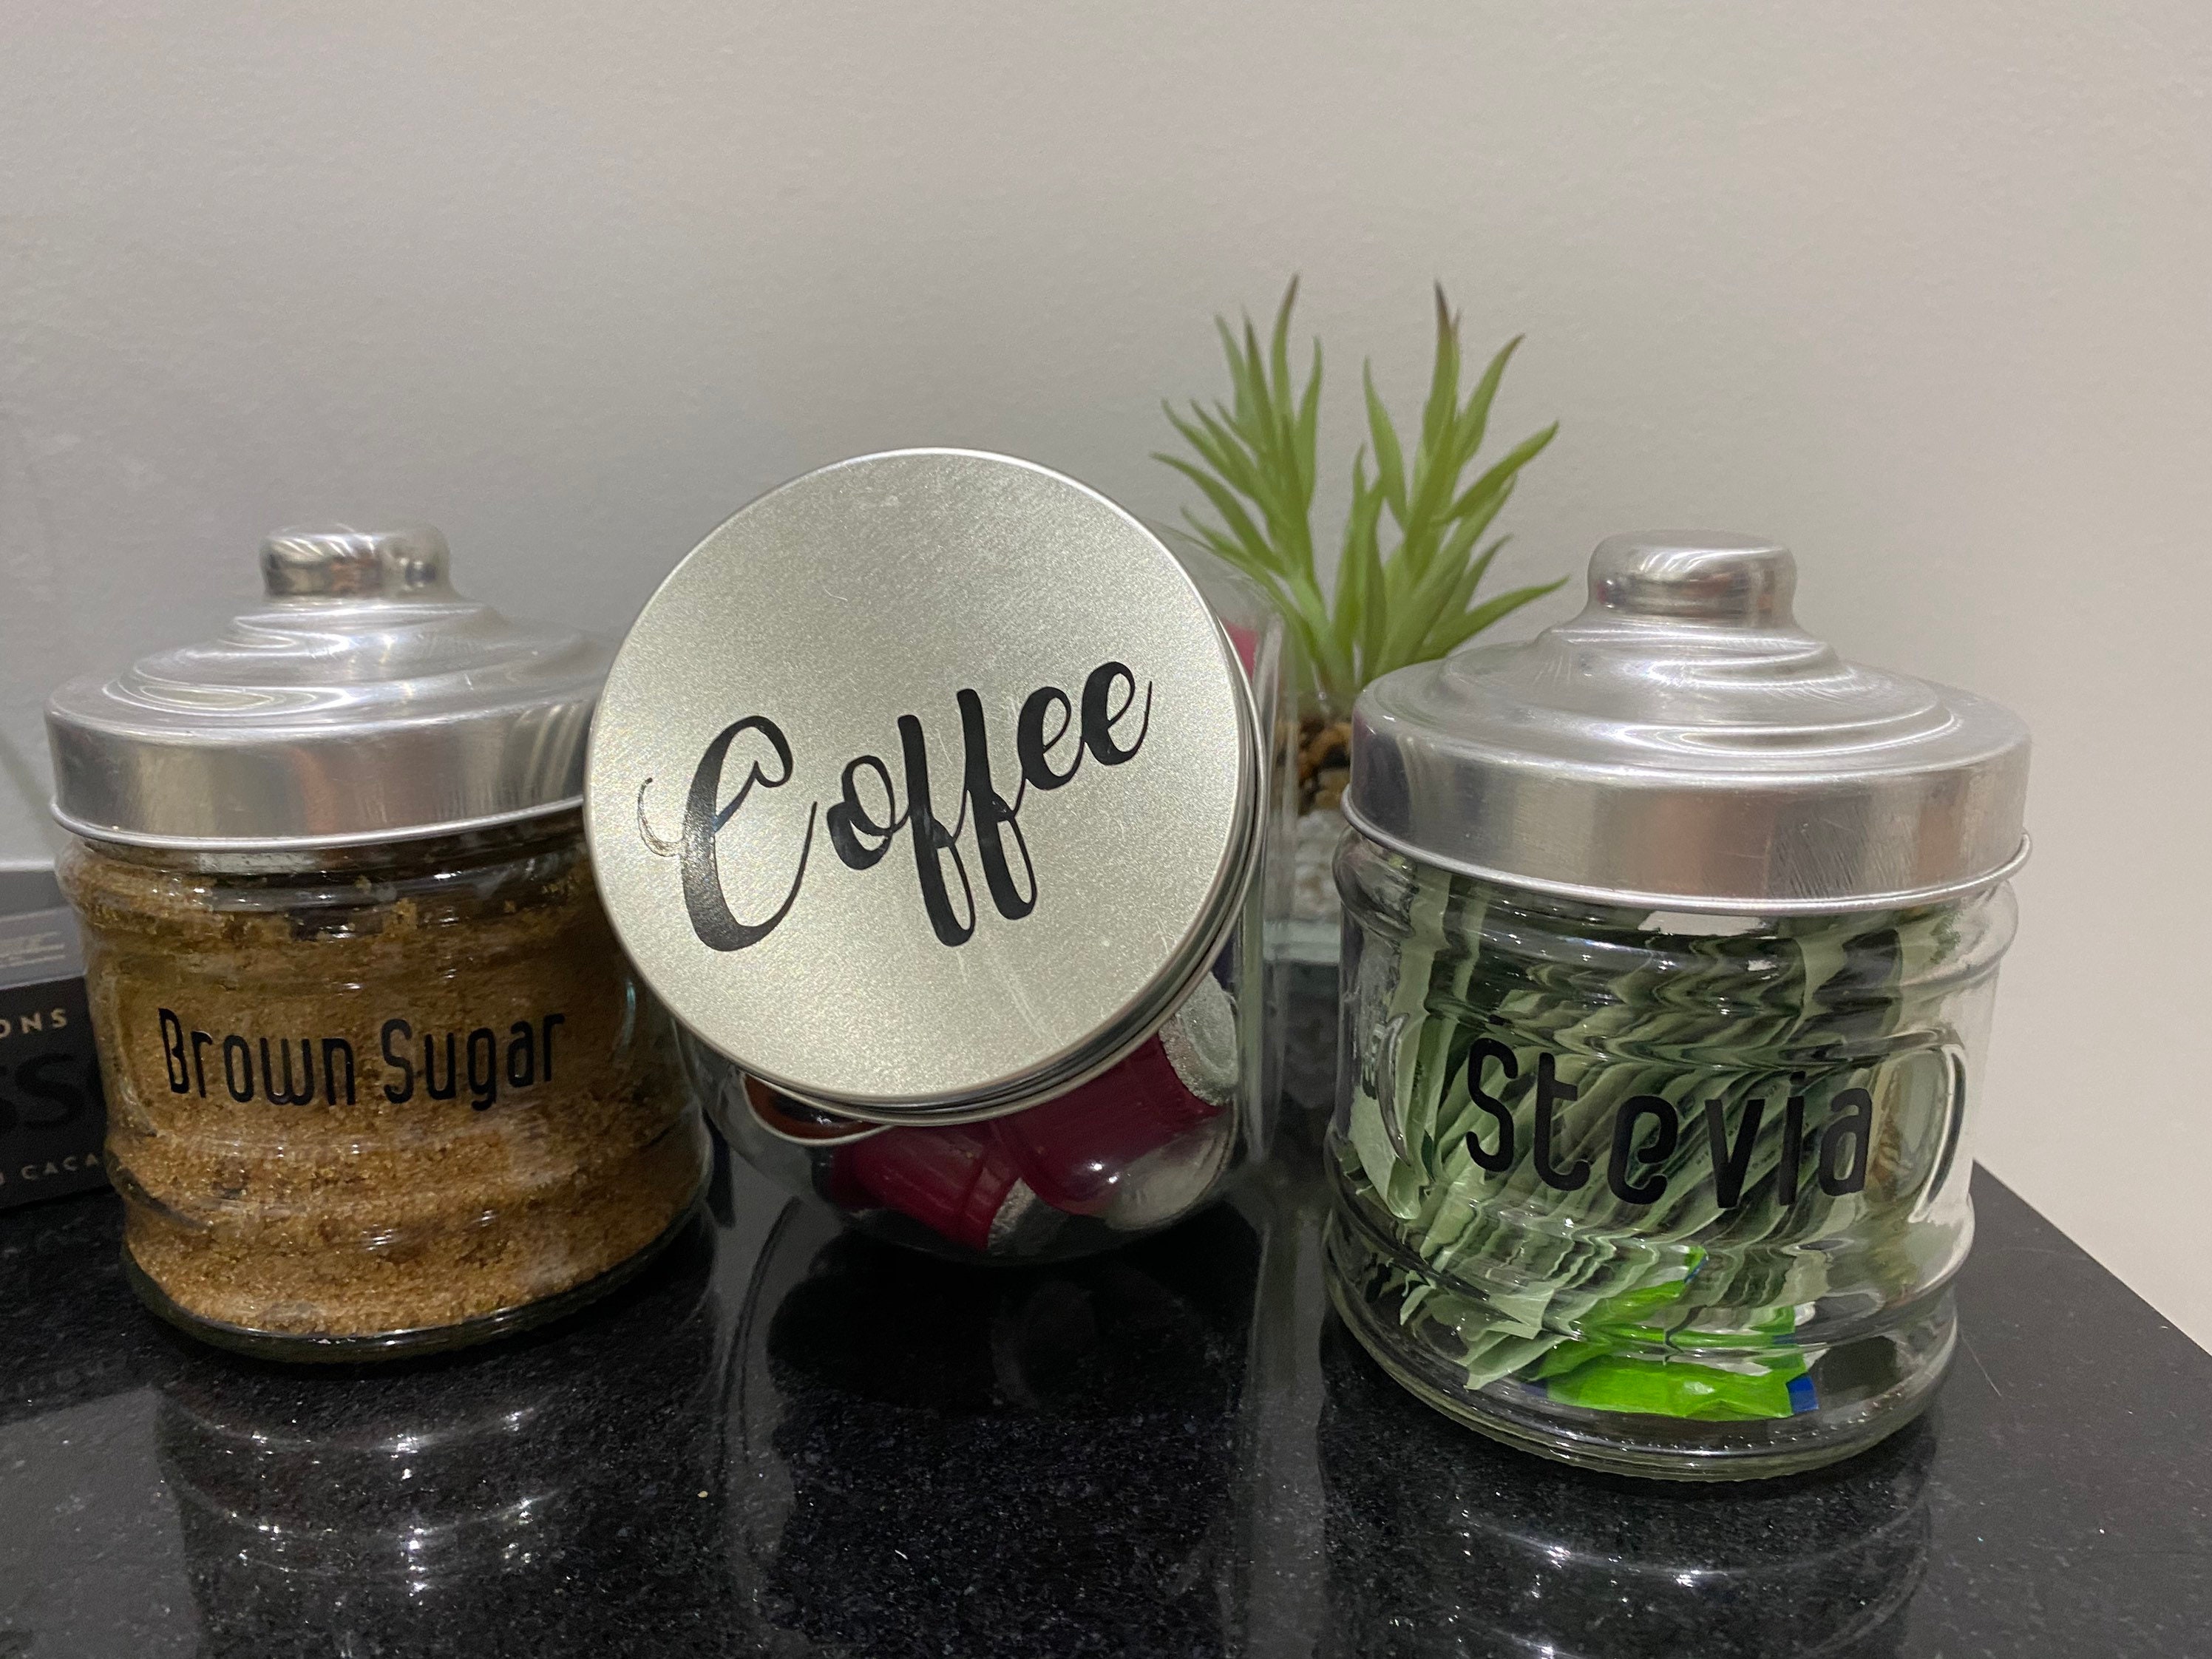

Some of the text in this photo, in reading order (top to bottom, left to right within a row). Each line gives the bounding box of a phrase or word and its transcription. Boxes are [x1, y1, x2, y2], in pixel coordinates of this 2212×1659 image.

[636, 662, 1153, 951] Coffee
[157, 1008, 356, 1105] Brown
[381, 1013, 566, 1109] Sugar
[1465, 1037, 1873, 1209] Stevia
